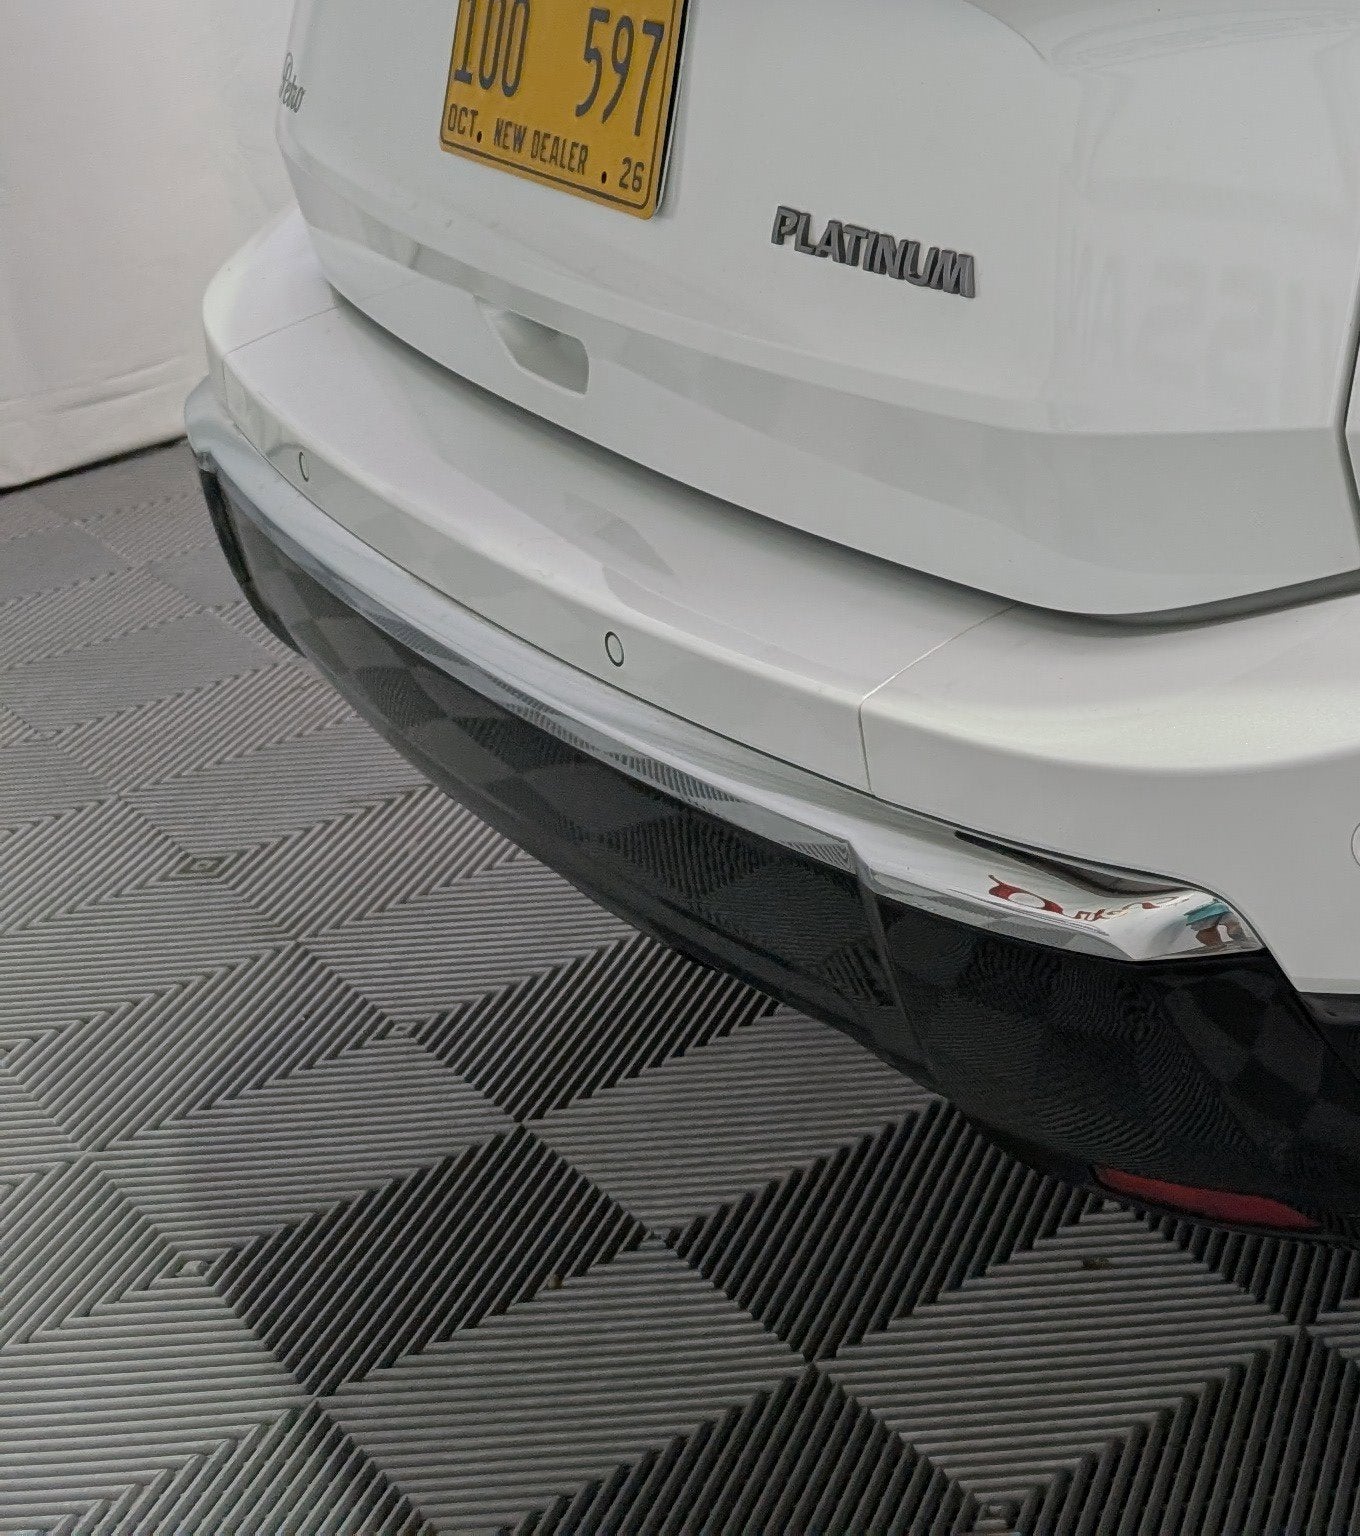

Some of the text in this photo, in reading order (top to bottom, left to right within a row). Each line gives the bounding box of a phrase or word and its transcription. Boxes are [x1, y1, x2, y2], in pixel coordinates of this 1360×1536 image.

[575, 8, 665, 137] 597
[493, 117, 529, 154] NEW
[530, 130, 589, 175] DEALER
[618, 157, 645, 192] 26
[771, 206, 975, 299] PLATINUM
